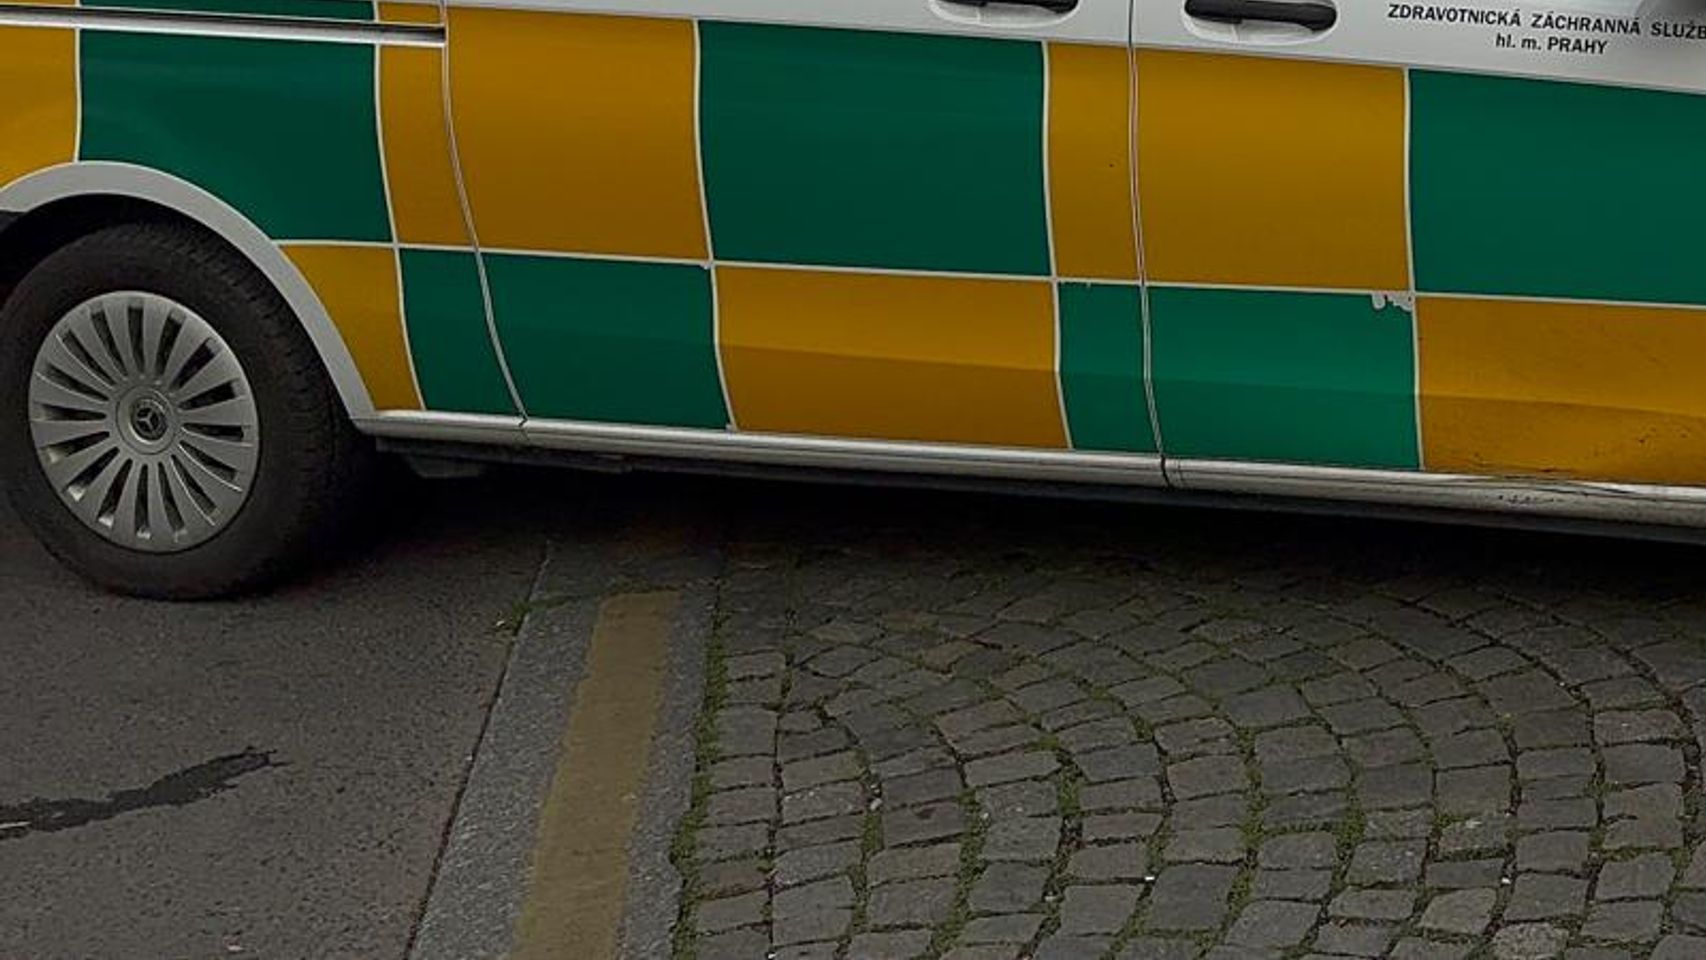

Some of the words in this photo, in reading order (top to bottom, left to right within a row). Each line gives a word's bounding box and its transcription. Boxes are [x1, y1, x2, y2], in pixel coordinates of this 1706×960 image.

[1387, 3, 1521, 27] ZDRAVOTNICKÁ
[1530, 11, 1641, 35] ZÁCHRANNÁ
[1495, 32, 1516, 48] hl.
[1521, 37, 1542, 50] m.
[1546, 36, 1609, 54] PRAHY
